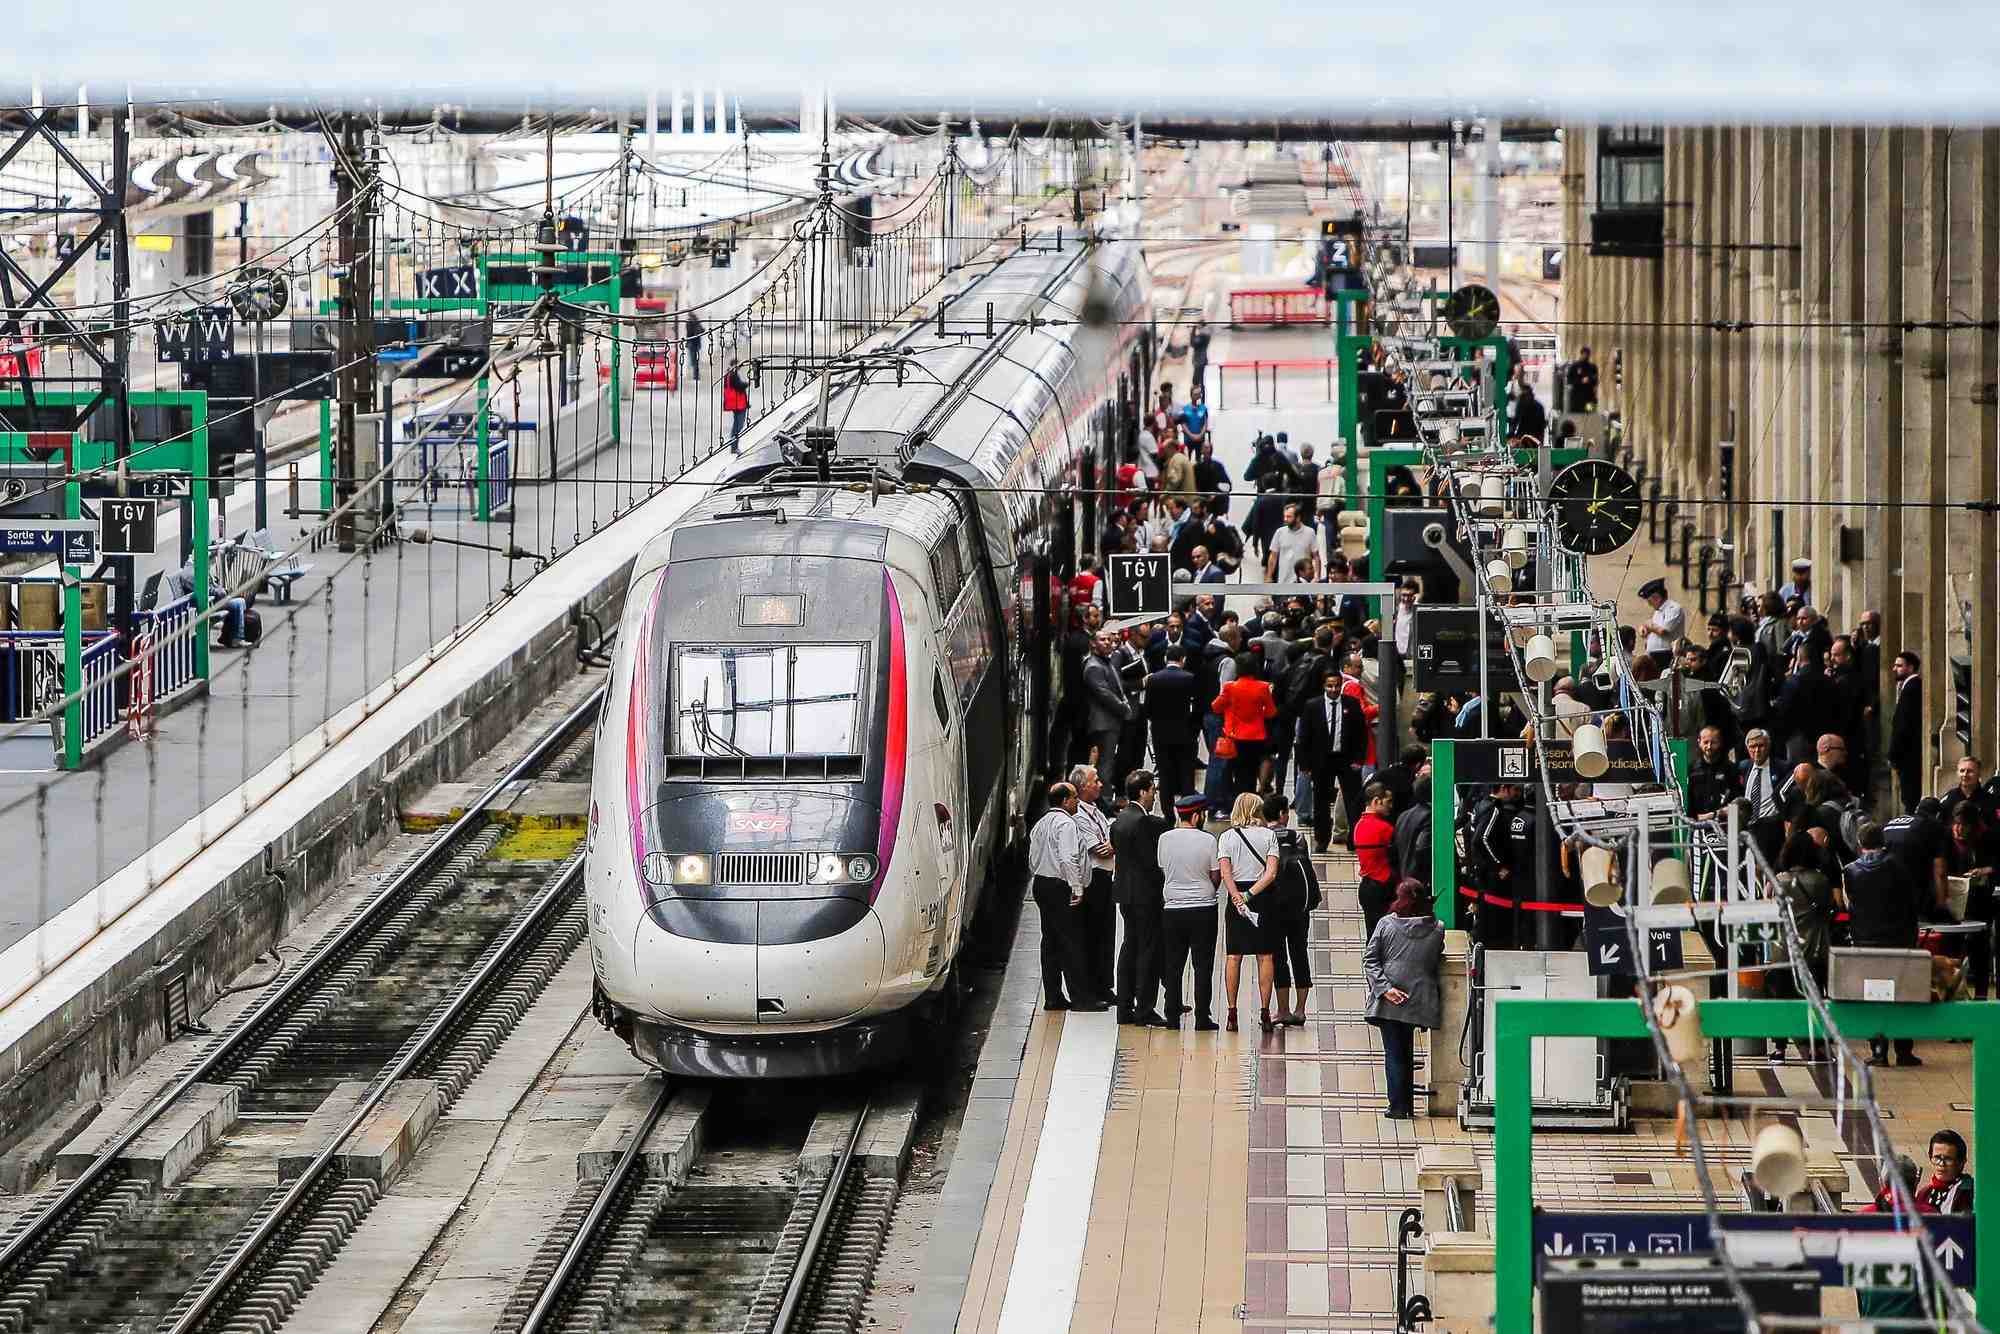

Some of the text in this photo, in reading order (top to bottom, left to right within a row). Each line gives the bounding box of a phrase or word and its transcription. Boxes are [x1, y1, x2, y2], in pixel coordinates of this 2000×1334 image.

[453, 272, 470, 294] X
[112, 504, 145, 521] TGV
[120, 523, 131, 550] 1
[1122, 560, 1158, 578] TGV
[1132, 581, 1142, 608] 1
[735, 818, 785, 831] SNCF
[1650, 931, 1671, 940] Voie
[1656, 943, 1666, 961] 1
